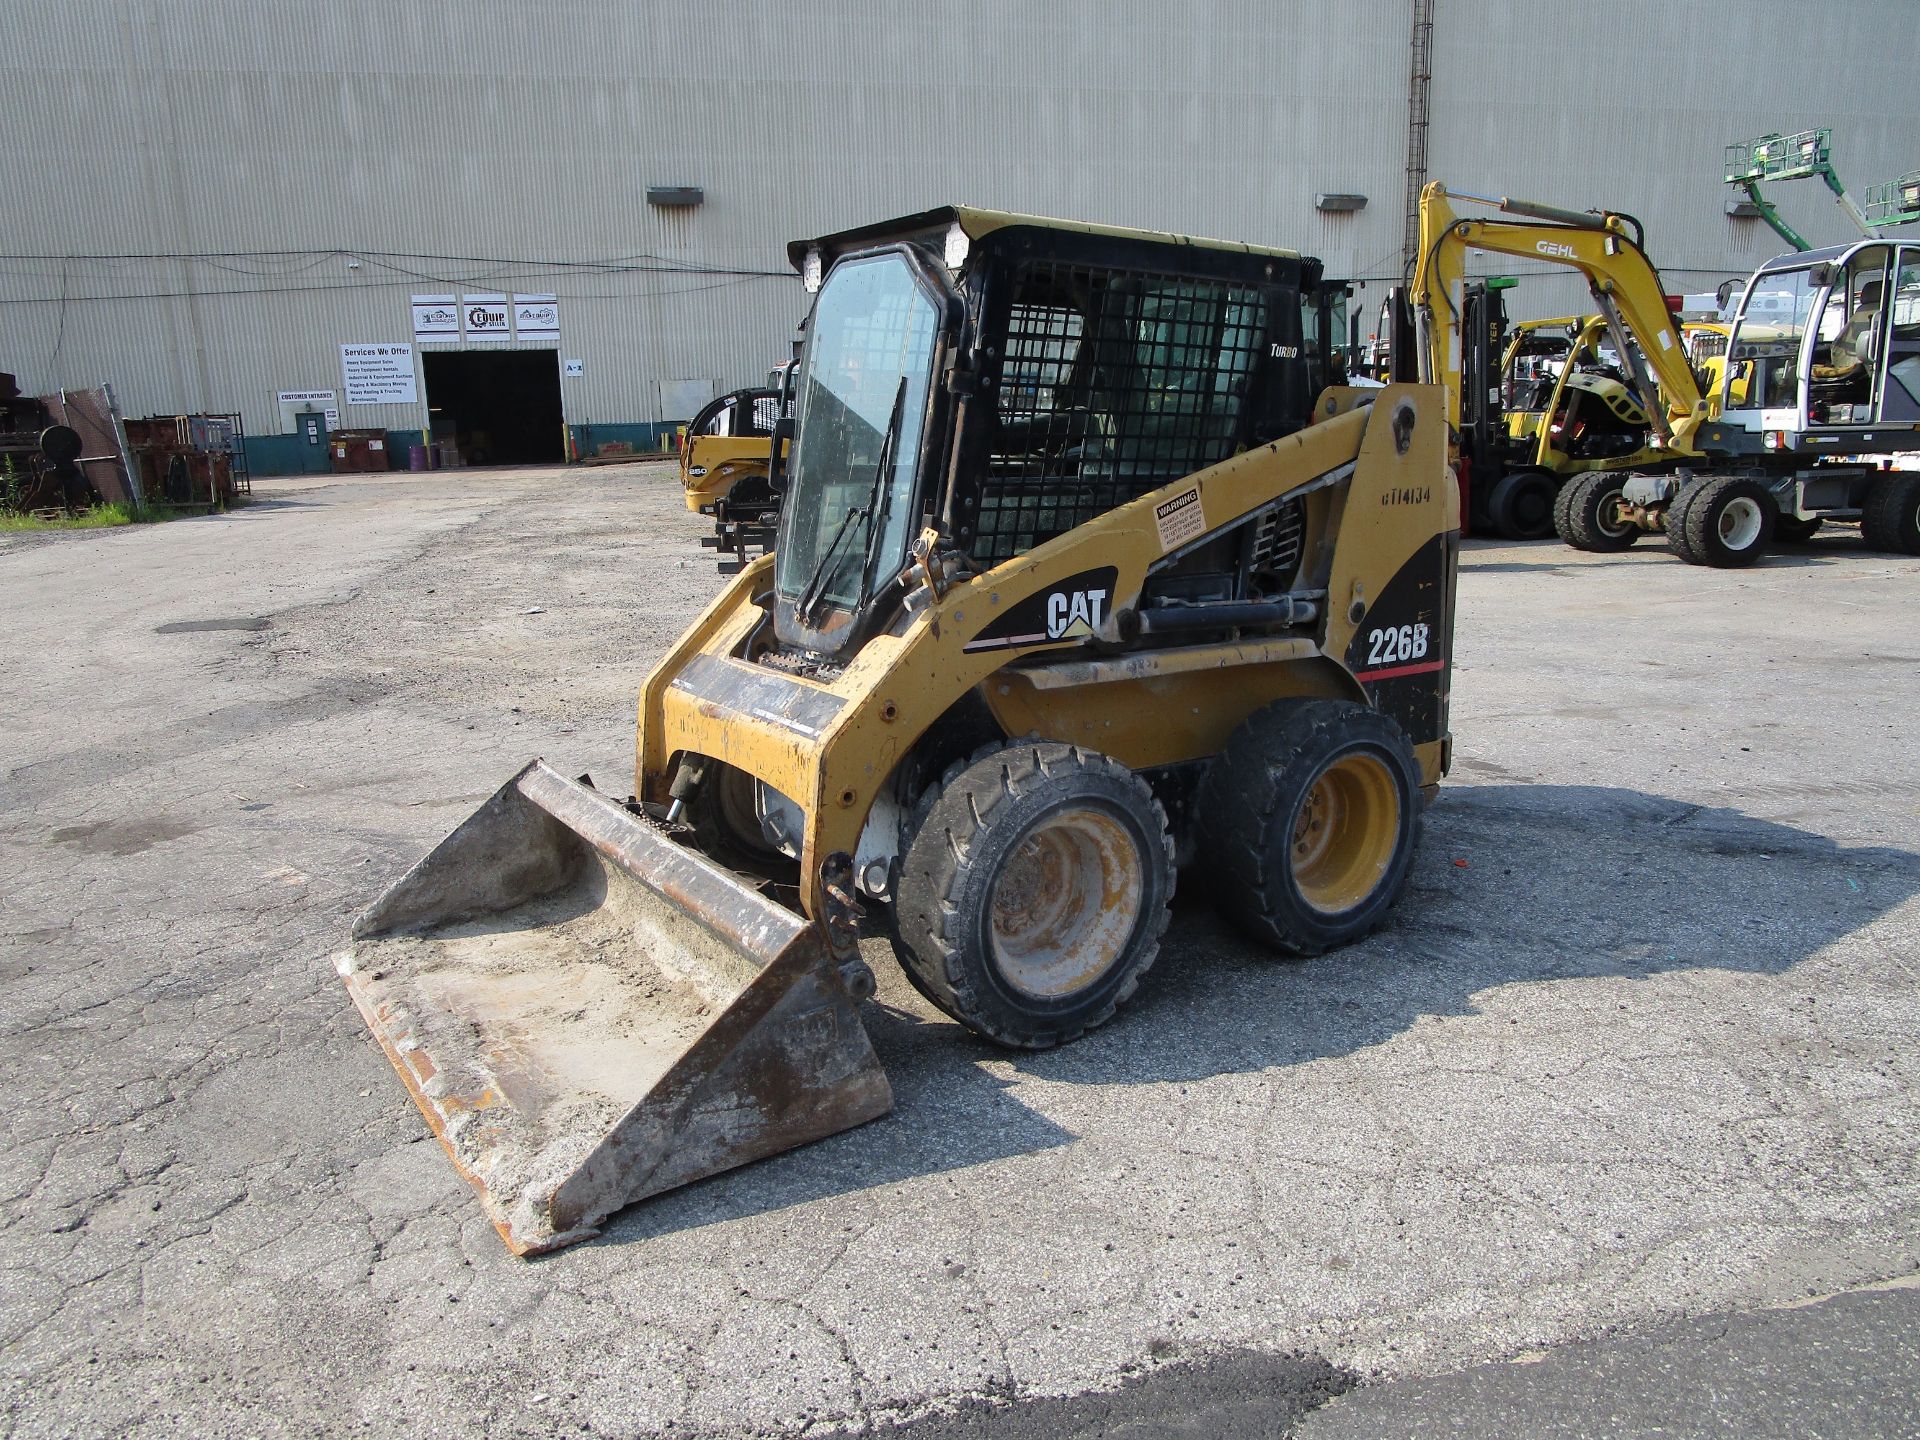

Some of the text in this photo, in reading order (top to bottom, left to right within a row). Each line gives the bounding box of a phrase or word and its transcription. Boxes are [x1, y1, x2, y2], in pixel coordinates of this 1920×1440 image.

[1536, 240, 1578, 259] GEHL
[477, 312, 505, 322] EQUIP
[344, 348, 376, 356] Services
[1271, 343, 1298, 359] TURBO
[1158, 491, 1198, 517] WARNING
[1047, 589, 1106, 639] CAT
[1367, 623, 1429, 665] 226B
